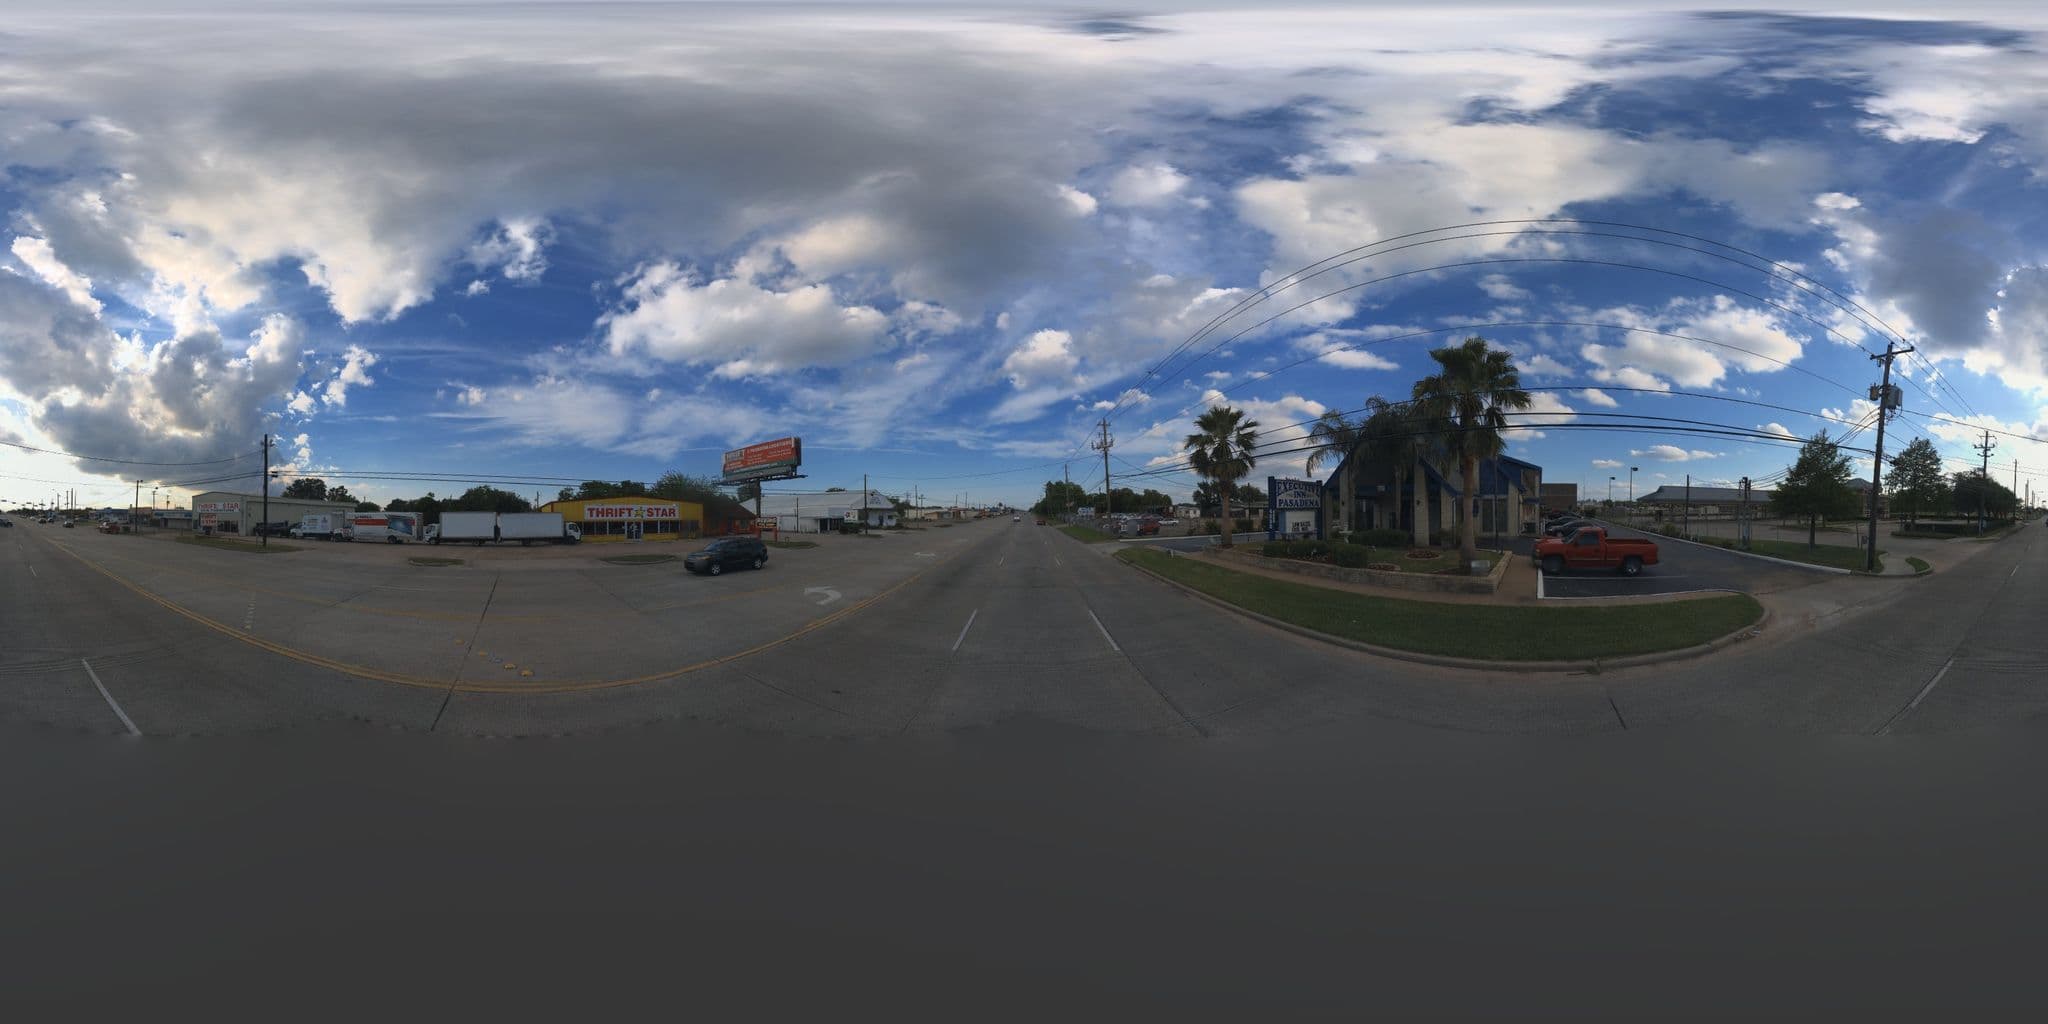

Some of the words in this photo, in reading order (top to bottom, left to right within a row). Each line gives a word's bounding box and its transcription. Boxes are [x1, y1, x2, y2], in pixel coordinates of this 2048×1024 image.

[1276, 481, 1320, 497] EXECUTIVE
[1294, 490, 1306, 498] INN
[1278, 498, 1319, 507] PASADENA
[587, 507, 633, 518] THRIFT
[646, 507, 676, 518] STAR
